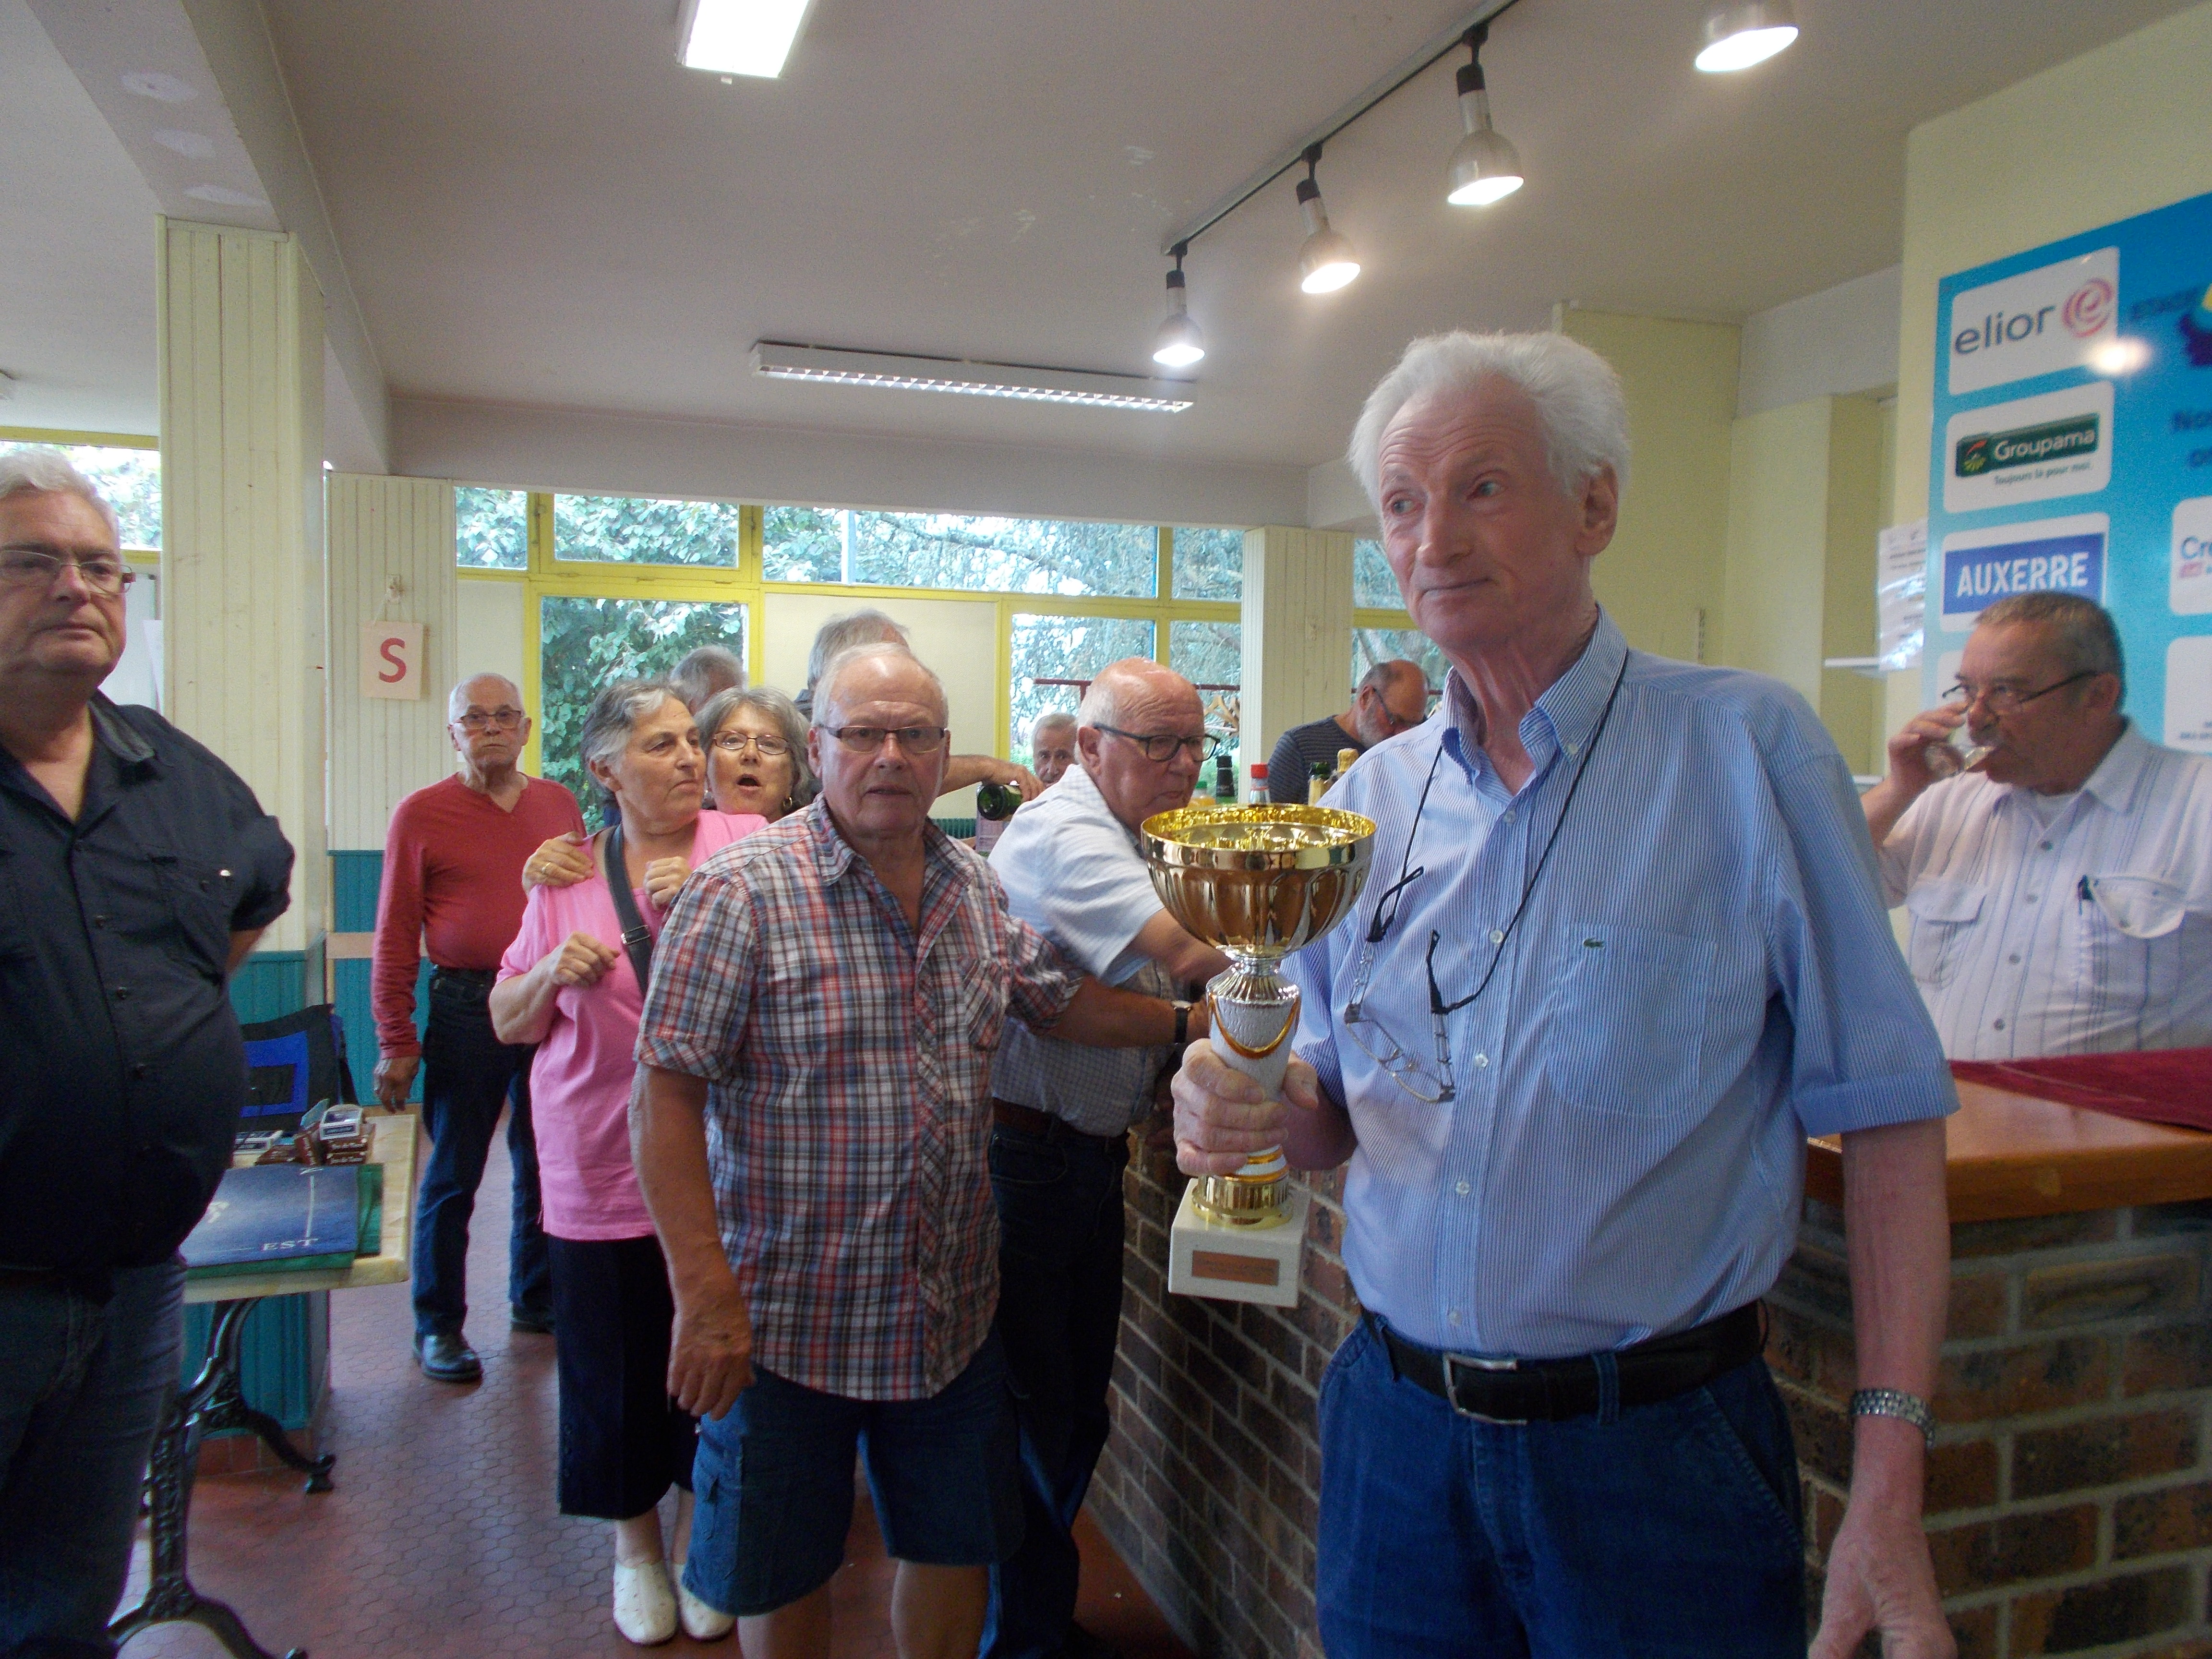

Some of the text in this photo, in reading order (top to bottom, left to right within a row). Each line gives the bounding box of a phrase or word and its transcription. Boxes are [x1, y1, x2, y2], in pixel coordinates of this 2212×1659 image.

[1954, 304, 2056, 355] elior
[1994, 429, 2095, 461] Groupama
[2181, 536, 2212, 560] Cr
[1957, 552, 2089, 598] AUXERRE
[378, 637, 407, 683] S
[262, 1238, 319, 1251] EST
